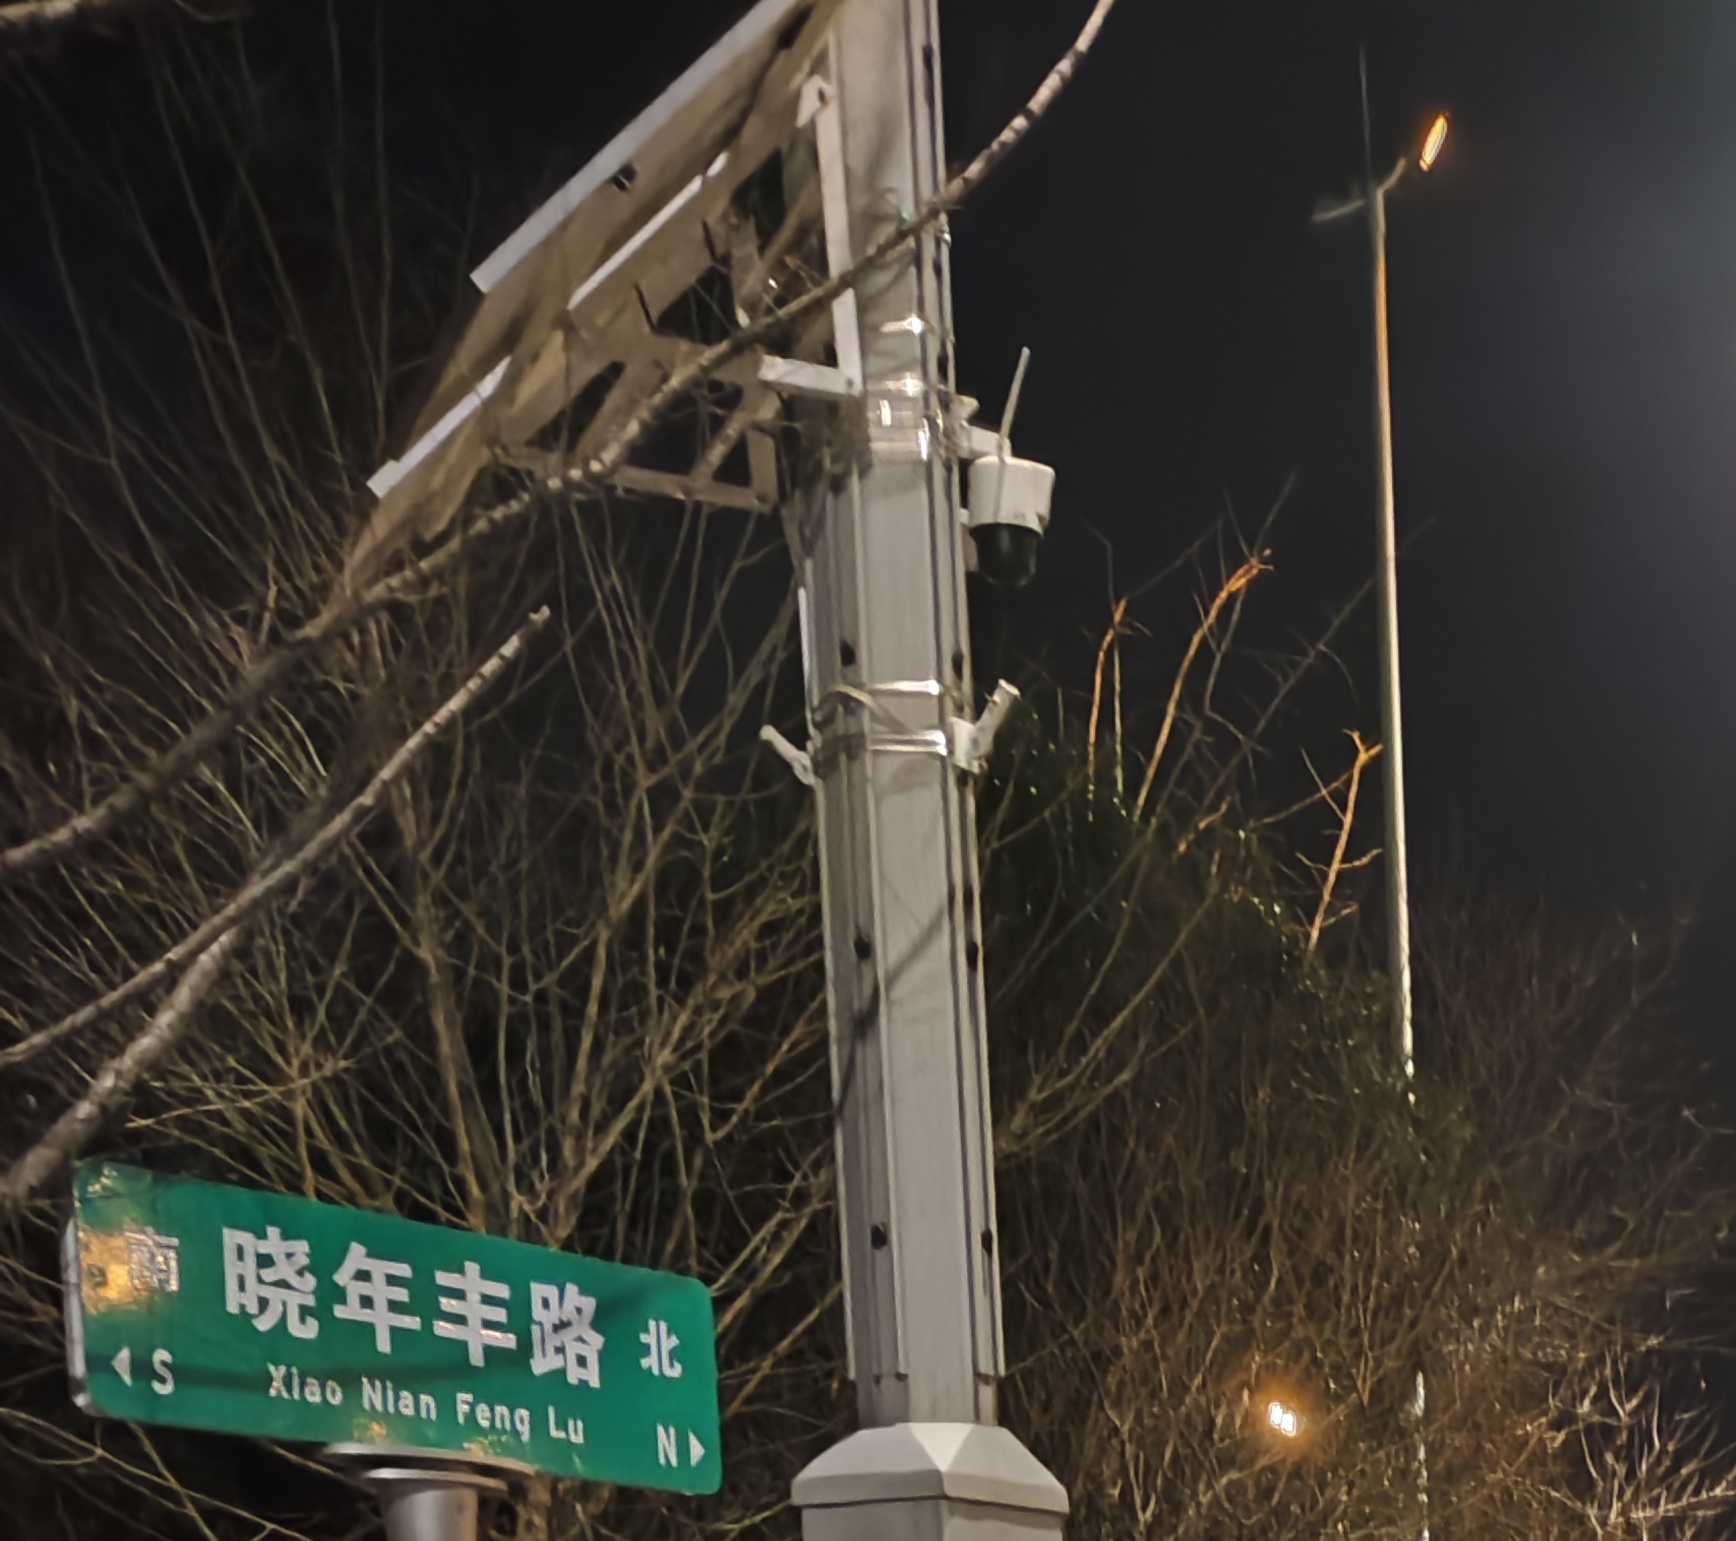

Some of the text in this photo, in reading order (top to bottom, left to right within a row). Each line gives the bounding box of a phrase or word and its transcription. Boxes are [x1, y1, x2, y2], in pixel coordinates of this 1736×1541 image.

[222, 1225, 604, 1388] 晓年丰路
[150, 1348, 174, 1396] S
[639, 1318, 682, 1379] 北
[267, 1362, 585, 1445] Xiao Nian Feng Lu
[656, 1423, 679, 1467] N
